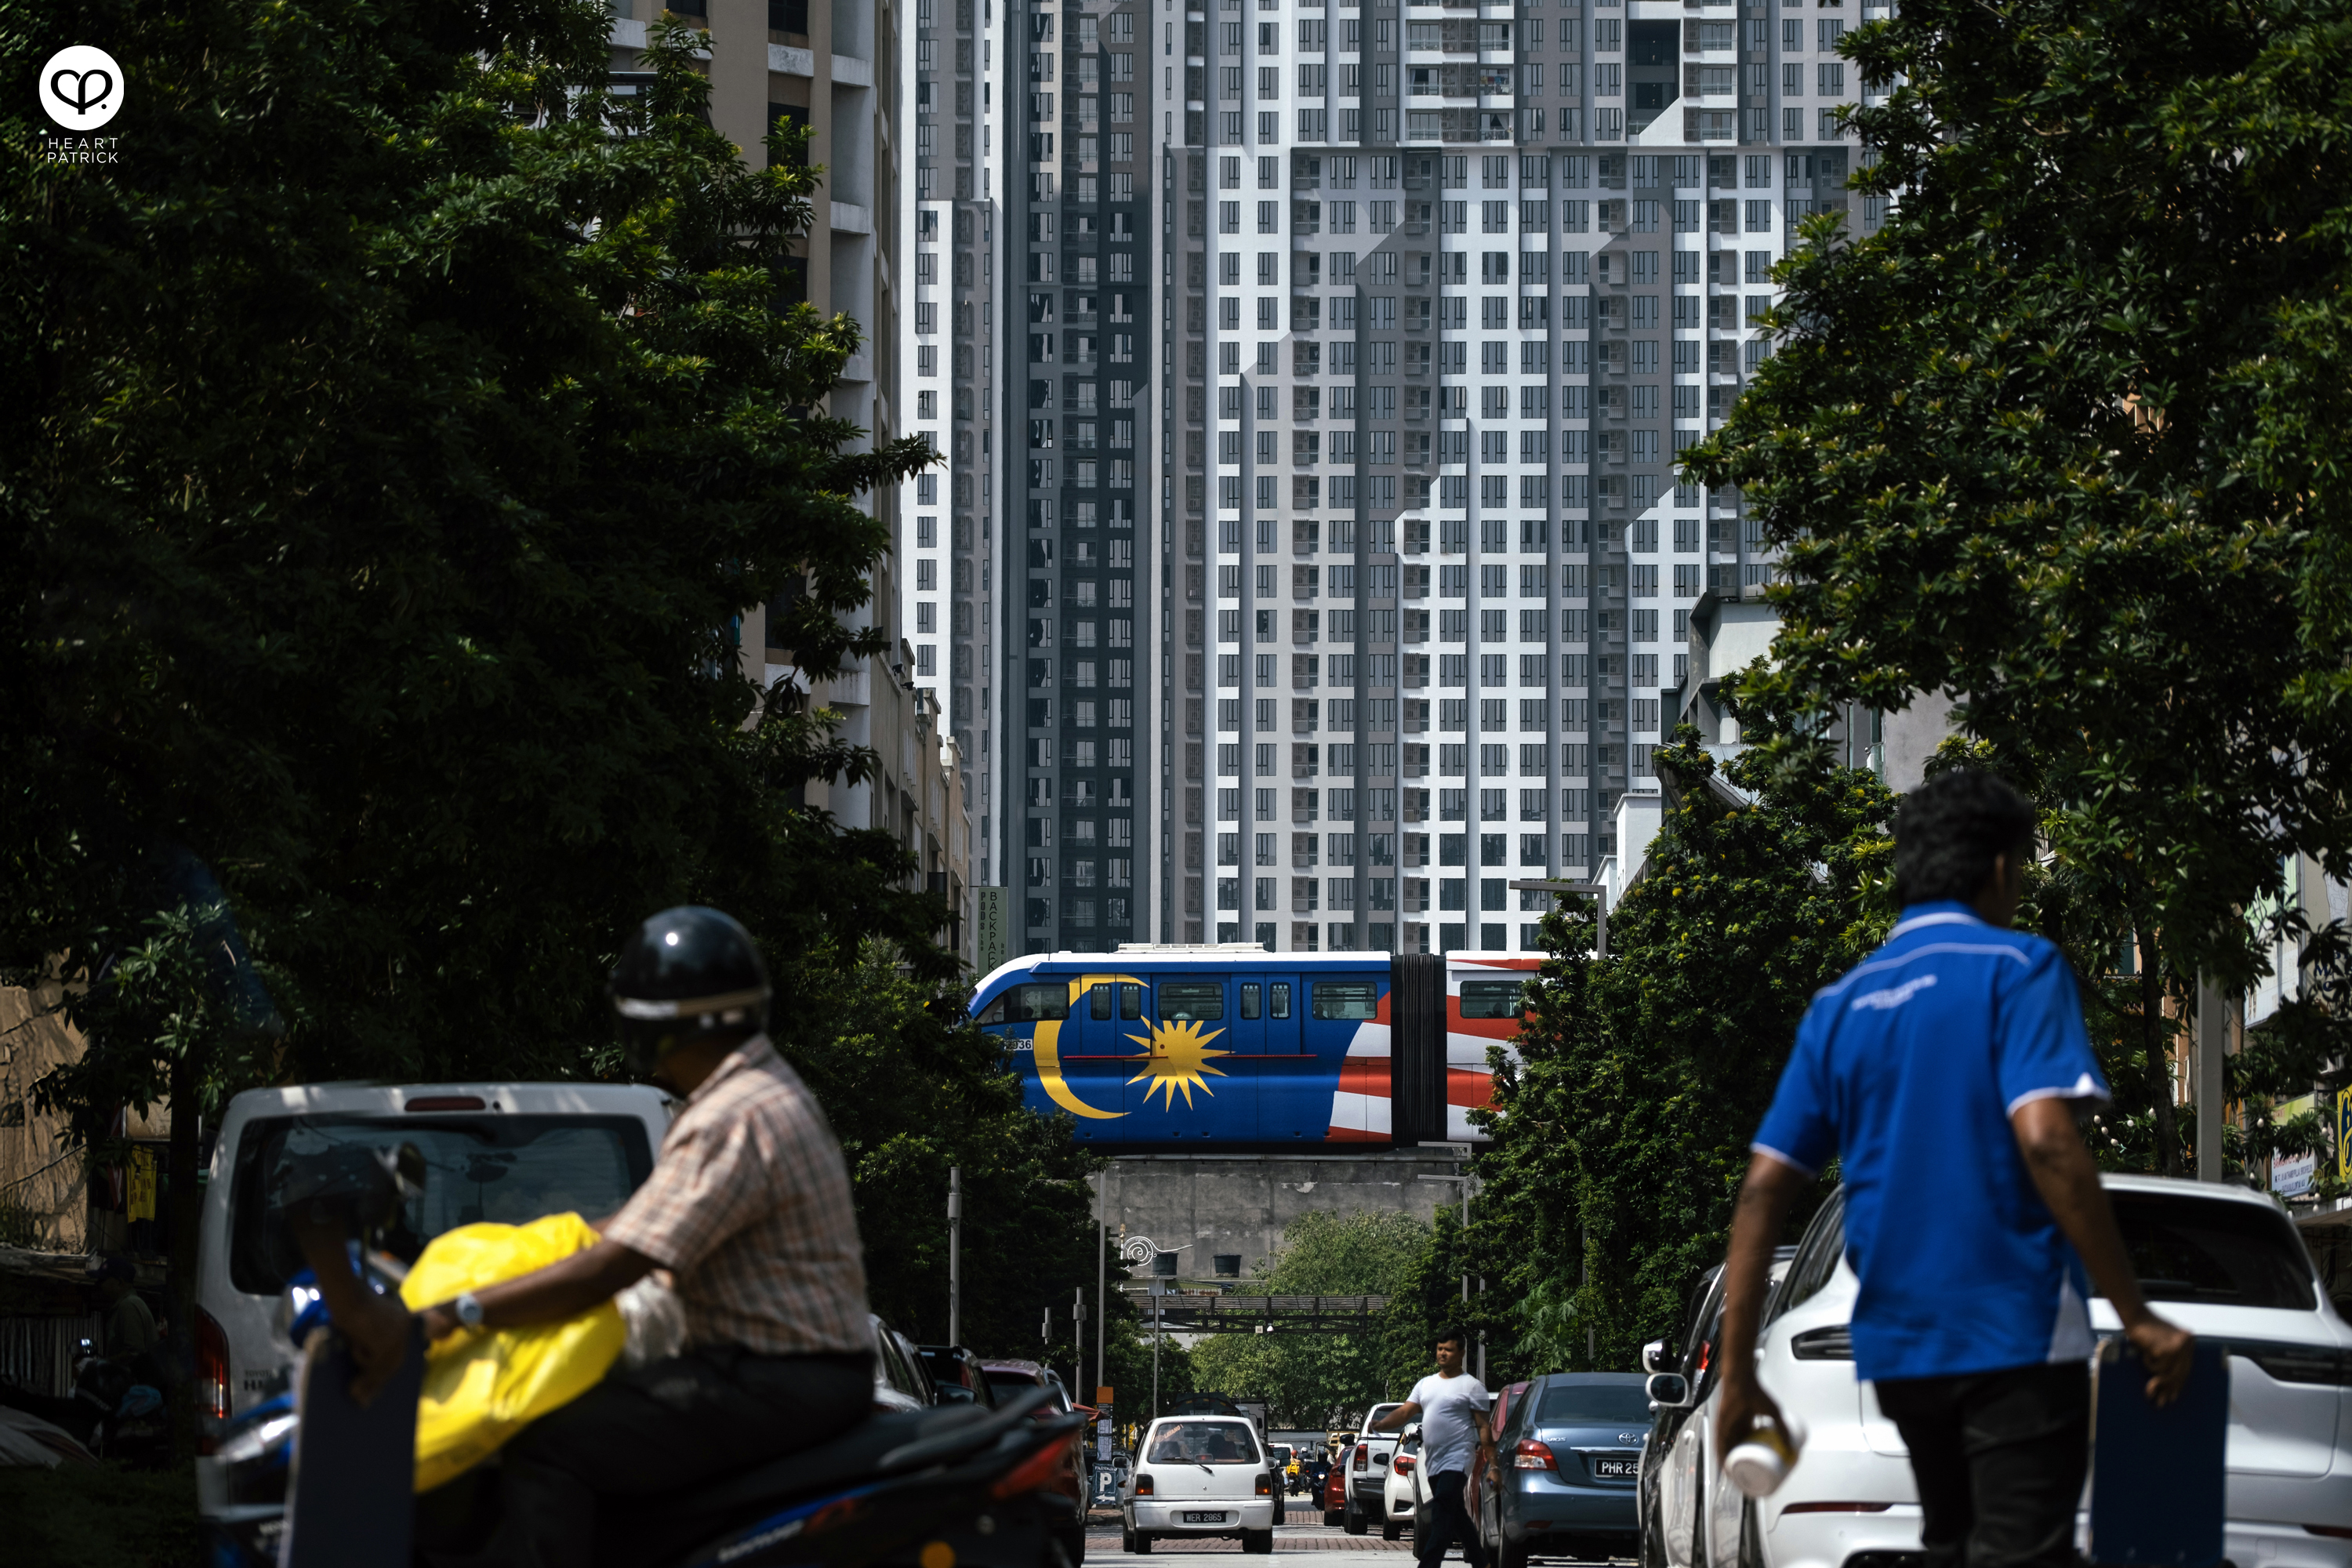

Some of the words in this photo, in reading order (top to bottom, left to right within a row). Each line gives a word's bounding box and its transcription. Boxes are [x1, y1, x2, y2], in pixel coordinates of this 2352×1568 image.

[1602, 1461, 1623, 1474] PHR
[1099, 1472, 1112, 1492] P
[1186, 1513, 1201, 1522] WER
